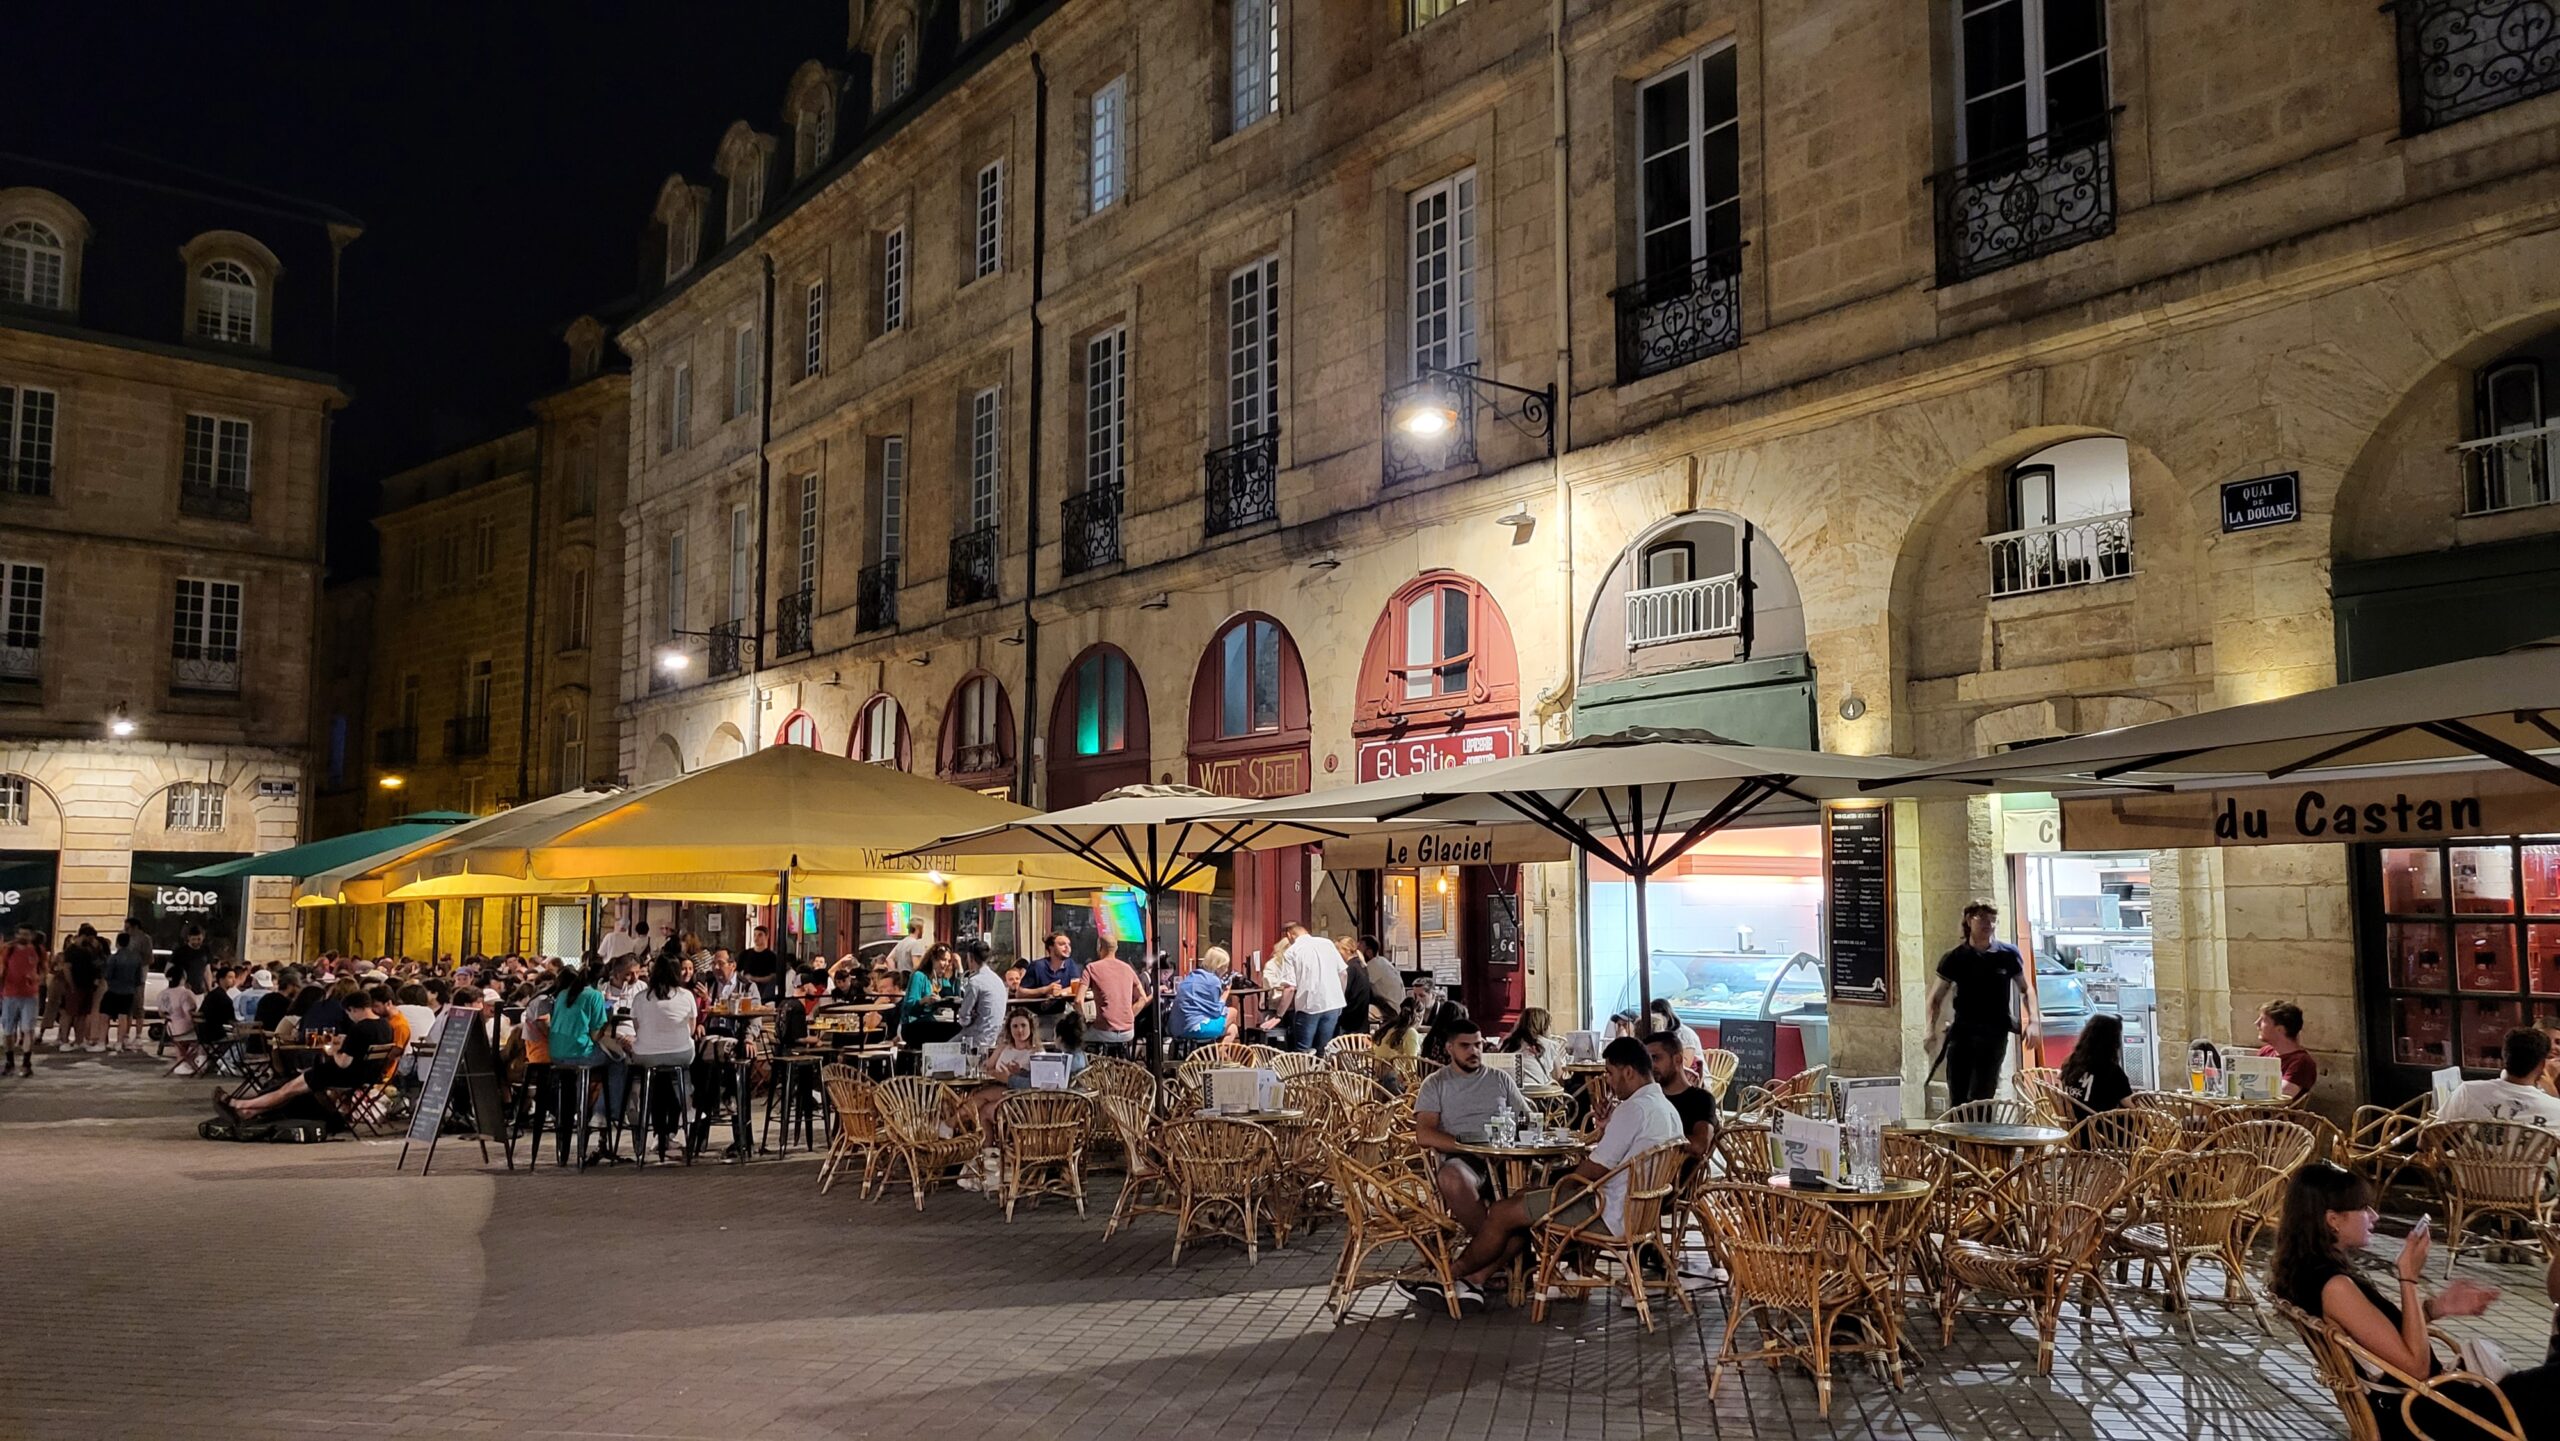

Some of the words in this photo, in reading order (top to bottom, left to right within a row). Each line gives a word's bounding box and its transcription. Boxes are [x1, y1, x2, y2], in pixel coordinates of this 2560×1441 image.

[2242, 483, 2273, 501] QUAI
[2252, 498, 2265, 506] DE
[2228, 511, 2244, 524] LA
[2247, 502, 2292, 521] DOUANE
[1847, 703, 1854, 716] 4
[1409, 743, 1456, 775] Sitio
[1198, 759, 1241, 797] WALL
[1248, 752, 1302, 798] STREET
[2215, 797, 2268, 840] du
[2295, 790, 2481, 837] Castan
[2039, 819, 2060, 843] C
[1386, 838, 1408, 864] Le
[1418, 834, 1492, 862] Glacier
[156, 886, 218, 905] icône
[1294, 880, 1300, 892] 6
